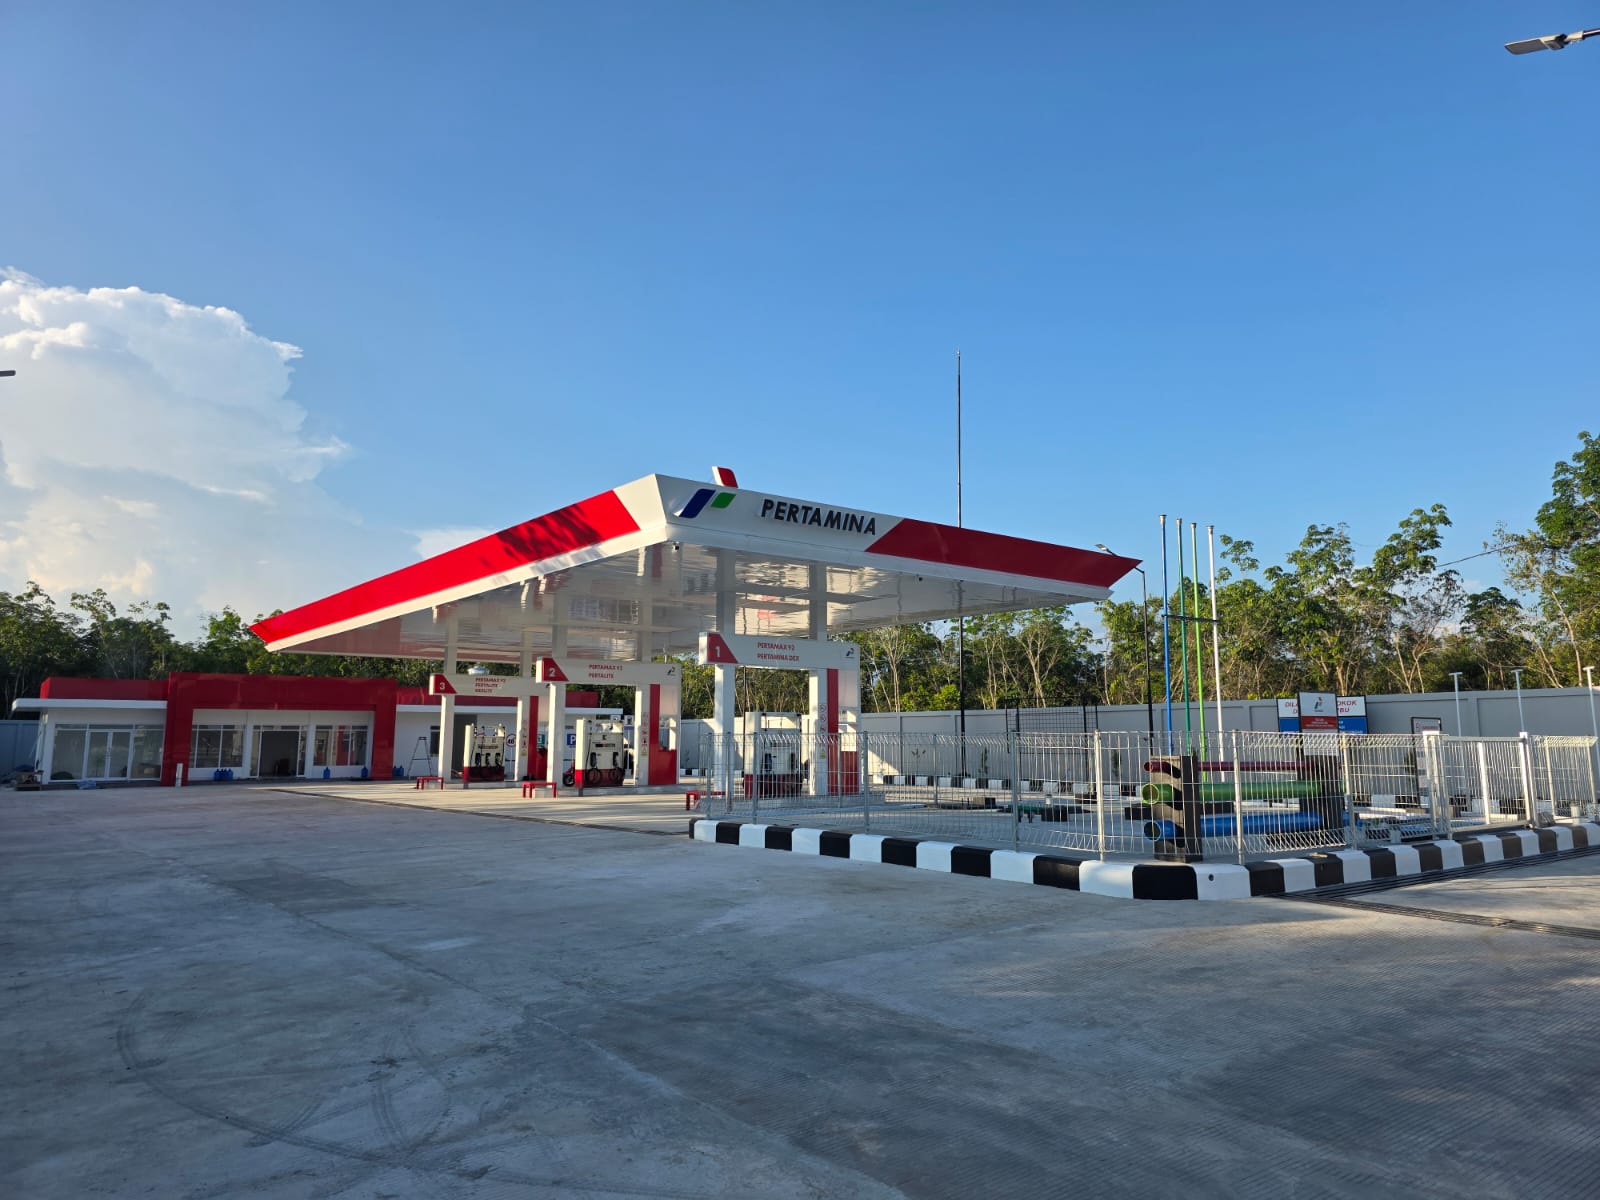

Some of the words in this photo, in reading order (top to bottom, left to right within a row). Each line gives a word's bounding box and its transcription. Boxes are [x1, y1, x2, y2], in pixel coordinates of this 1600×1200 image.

[761, 499, 877, 536] PERTAMINA
[757, 641, 787, 650] PERTAMAX
[714, 646, 721, 658] 1
[548, 667, 556, 678] 2
[439, 682, 446, 691] 3
